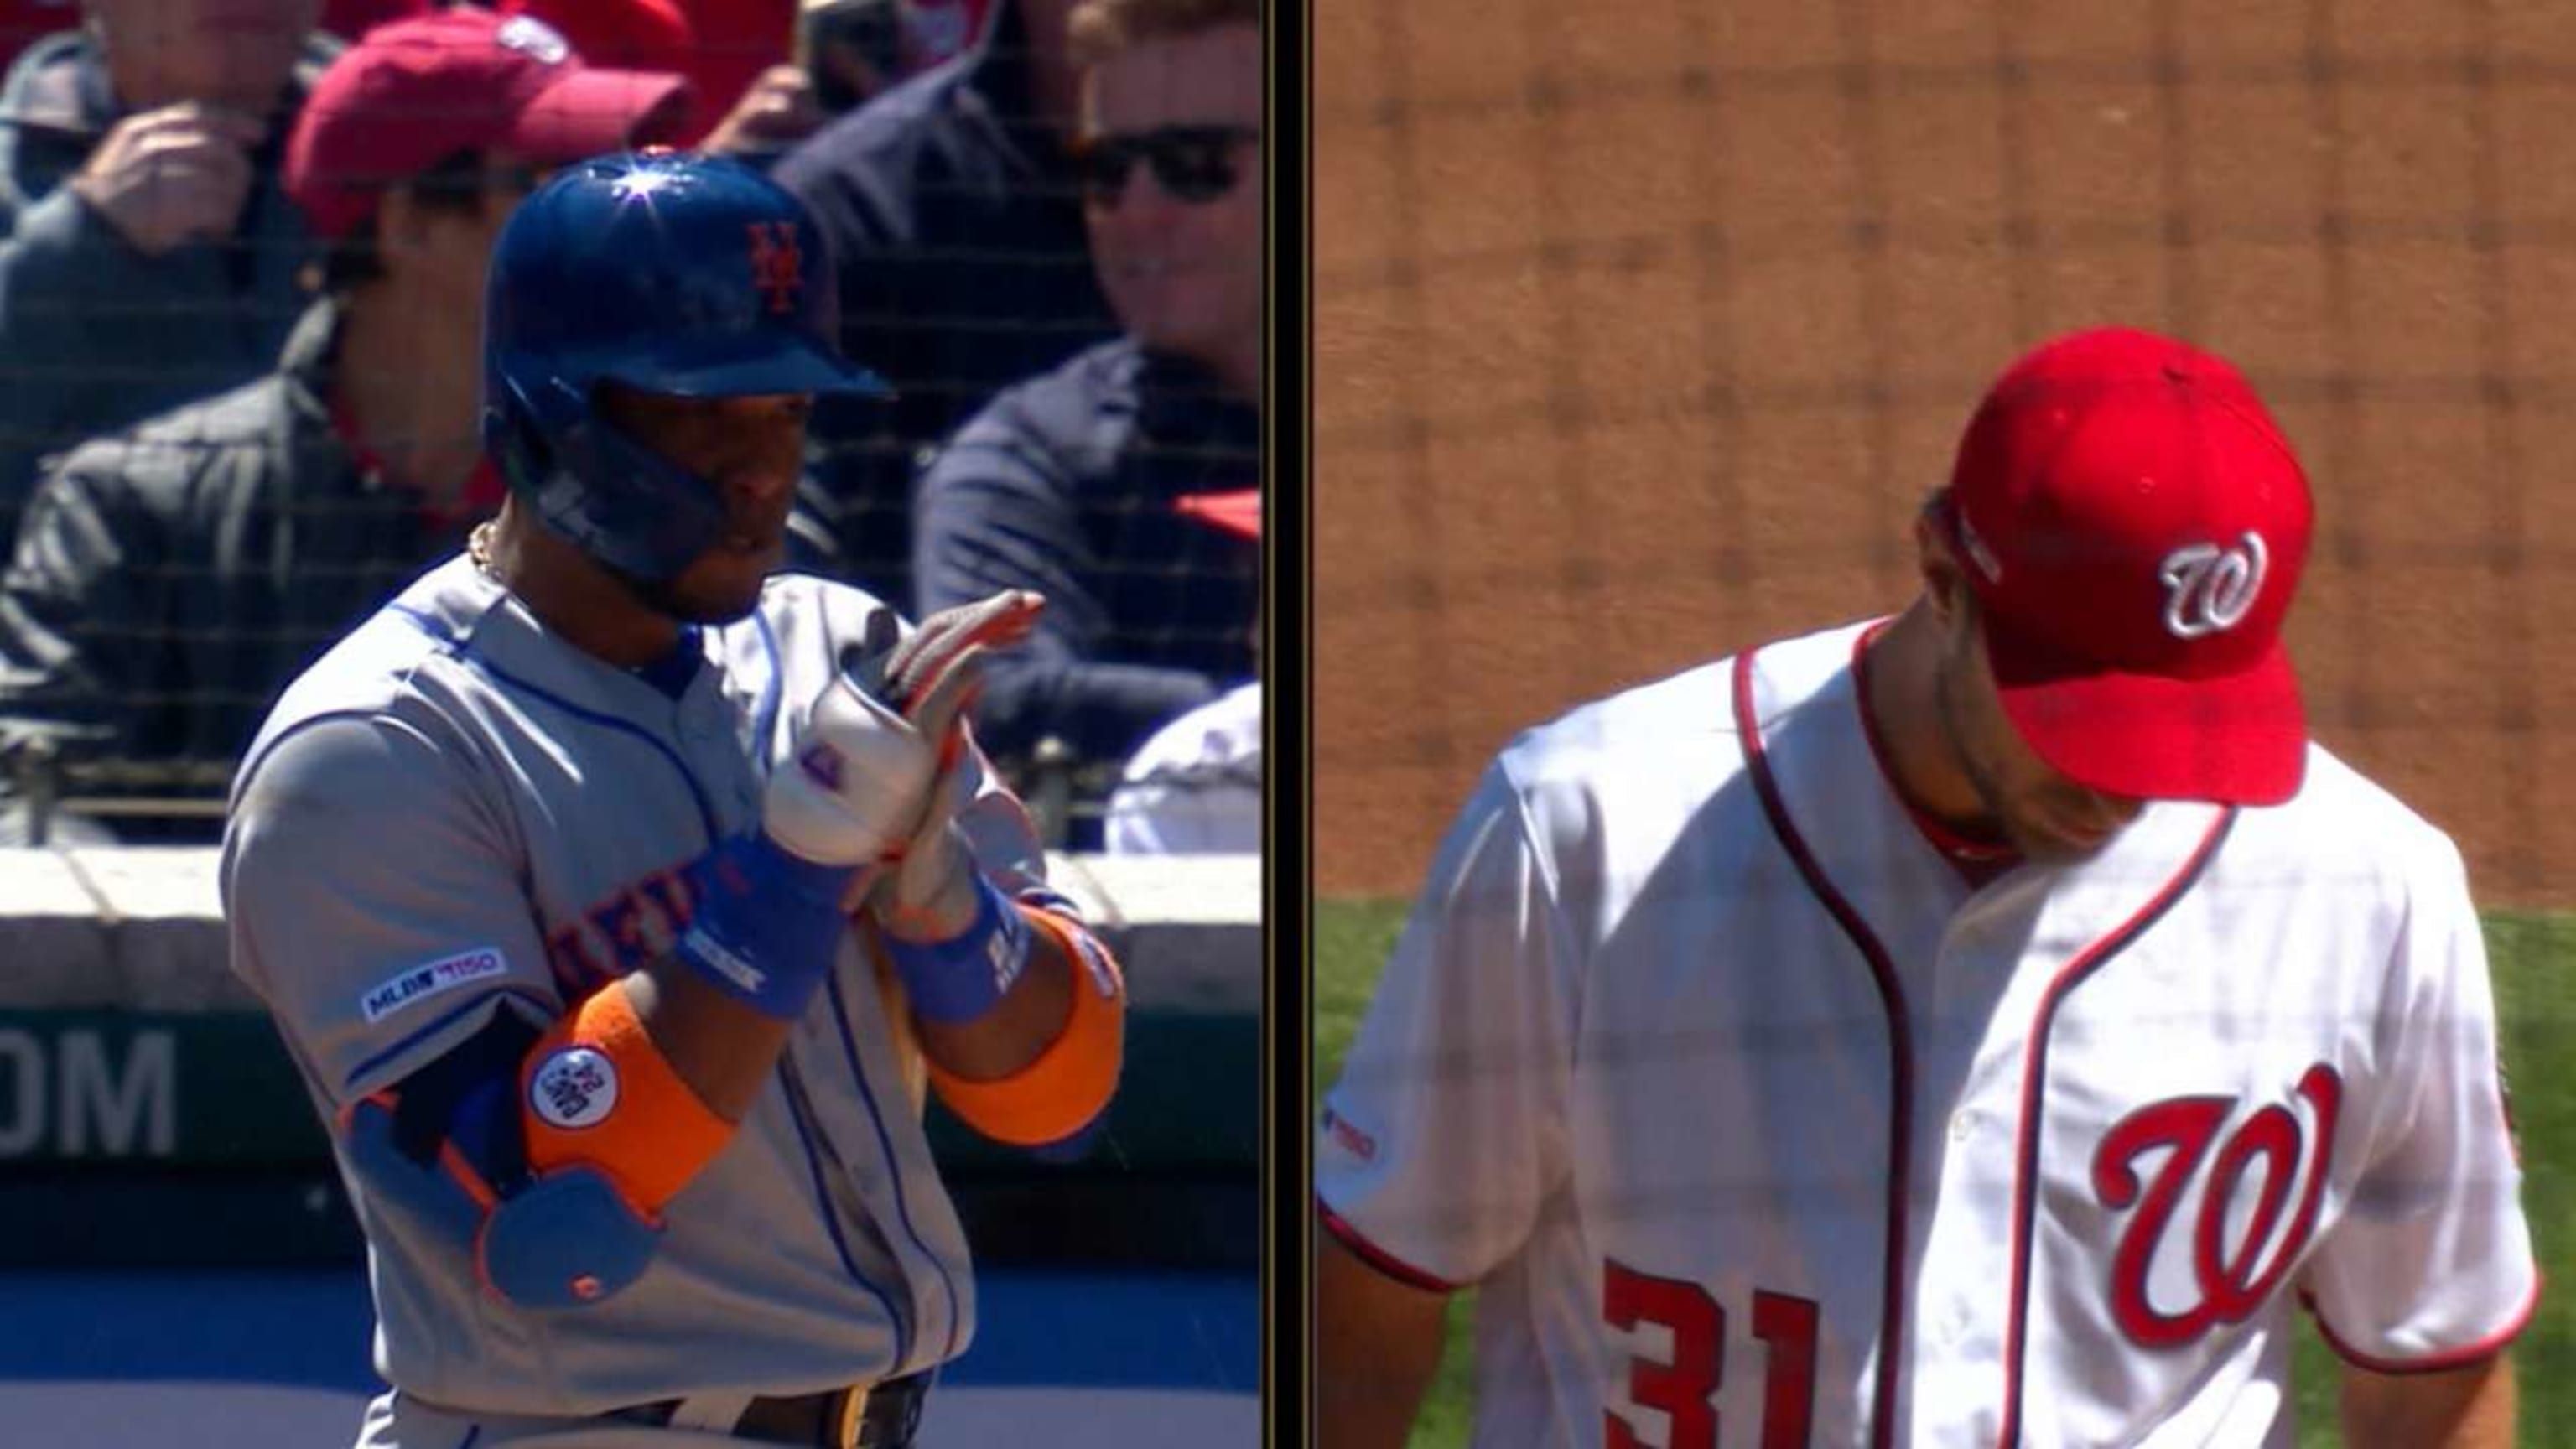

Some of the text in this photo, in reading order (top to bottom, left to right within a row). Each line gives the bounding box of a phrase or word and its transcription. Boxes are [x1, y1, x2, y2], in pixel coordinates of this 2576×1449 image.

[2161, 530, 2268, 639] W
[2091, 1061, 2344, 1354] W
[1602, 1255, 1820, 1449] 31
